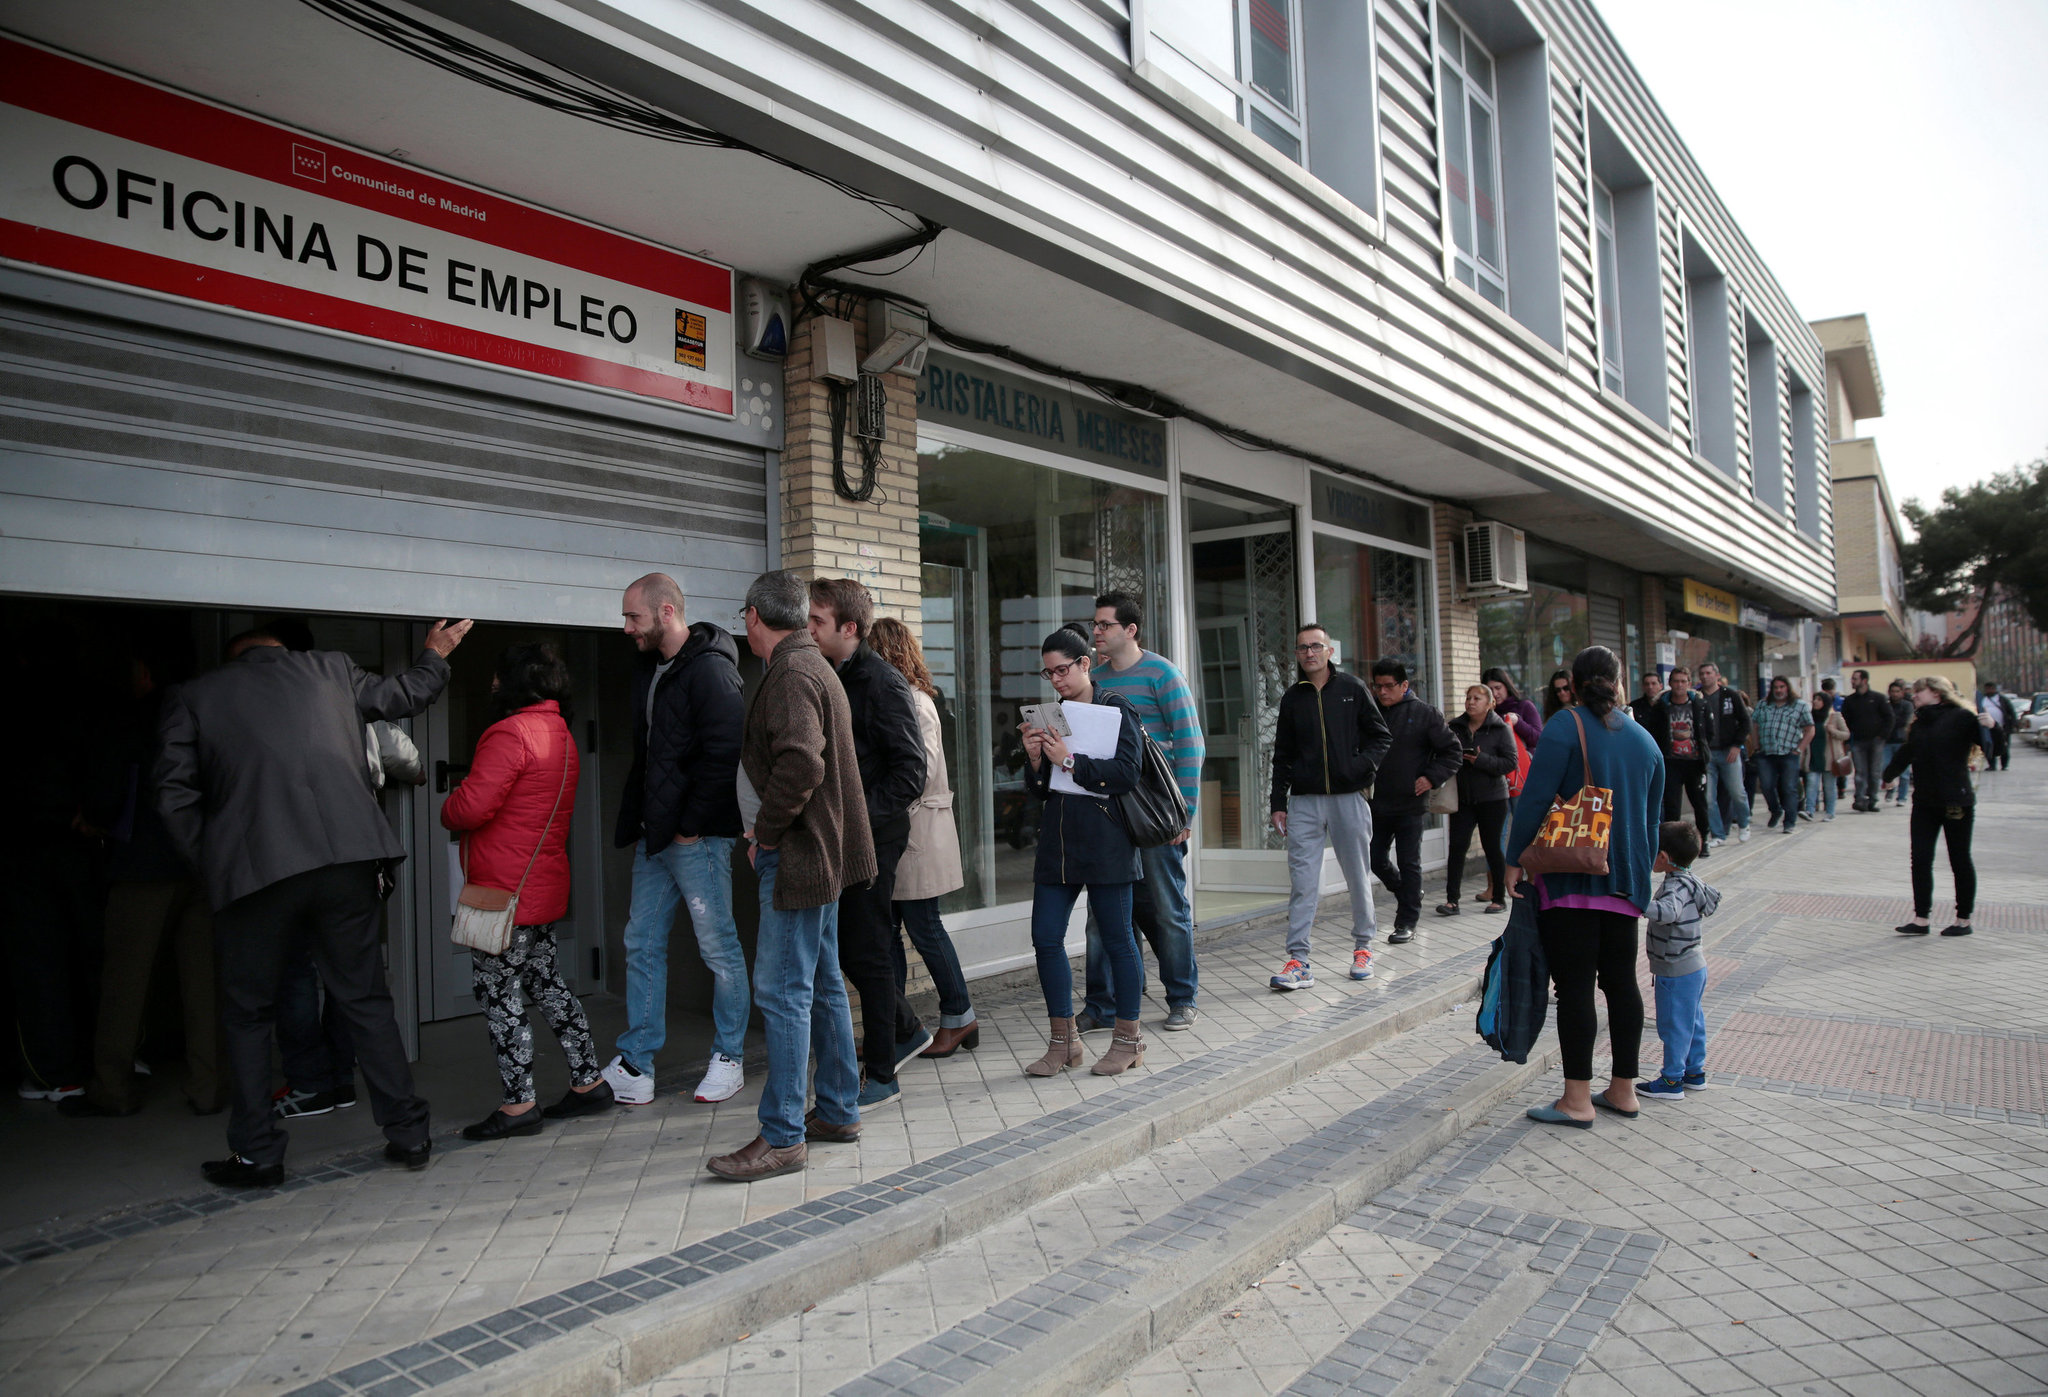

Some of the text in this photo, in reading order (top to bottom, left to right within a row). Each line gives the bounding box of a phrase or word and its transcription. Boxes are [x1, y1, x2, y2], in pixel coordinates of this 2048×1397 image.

[332, 165, 487, 222] Comunidad de Madrid
[52, 155, 637, 344] OFICINA DE EMPLEO
[916, 364, 1162, 468] CRISTALERIA MENESES
